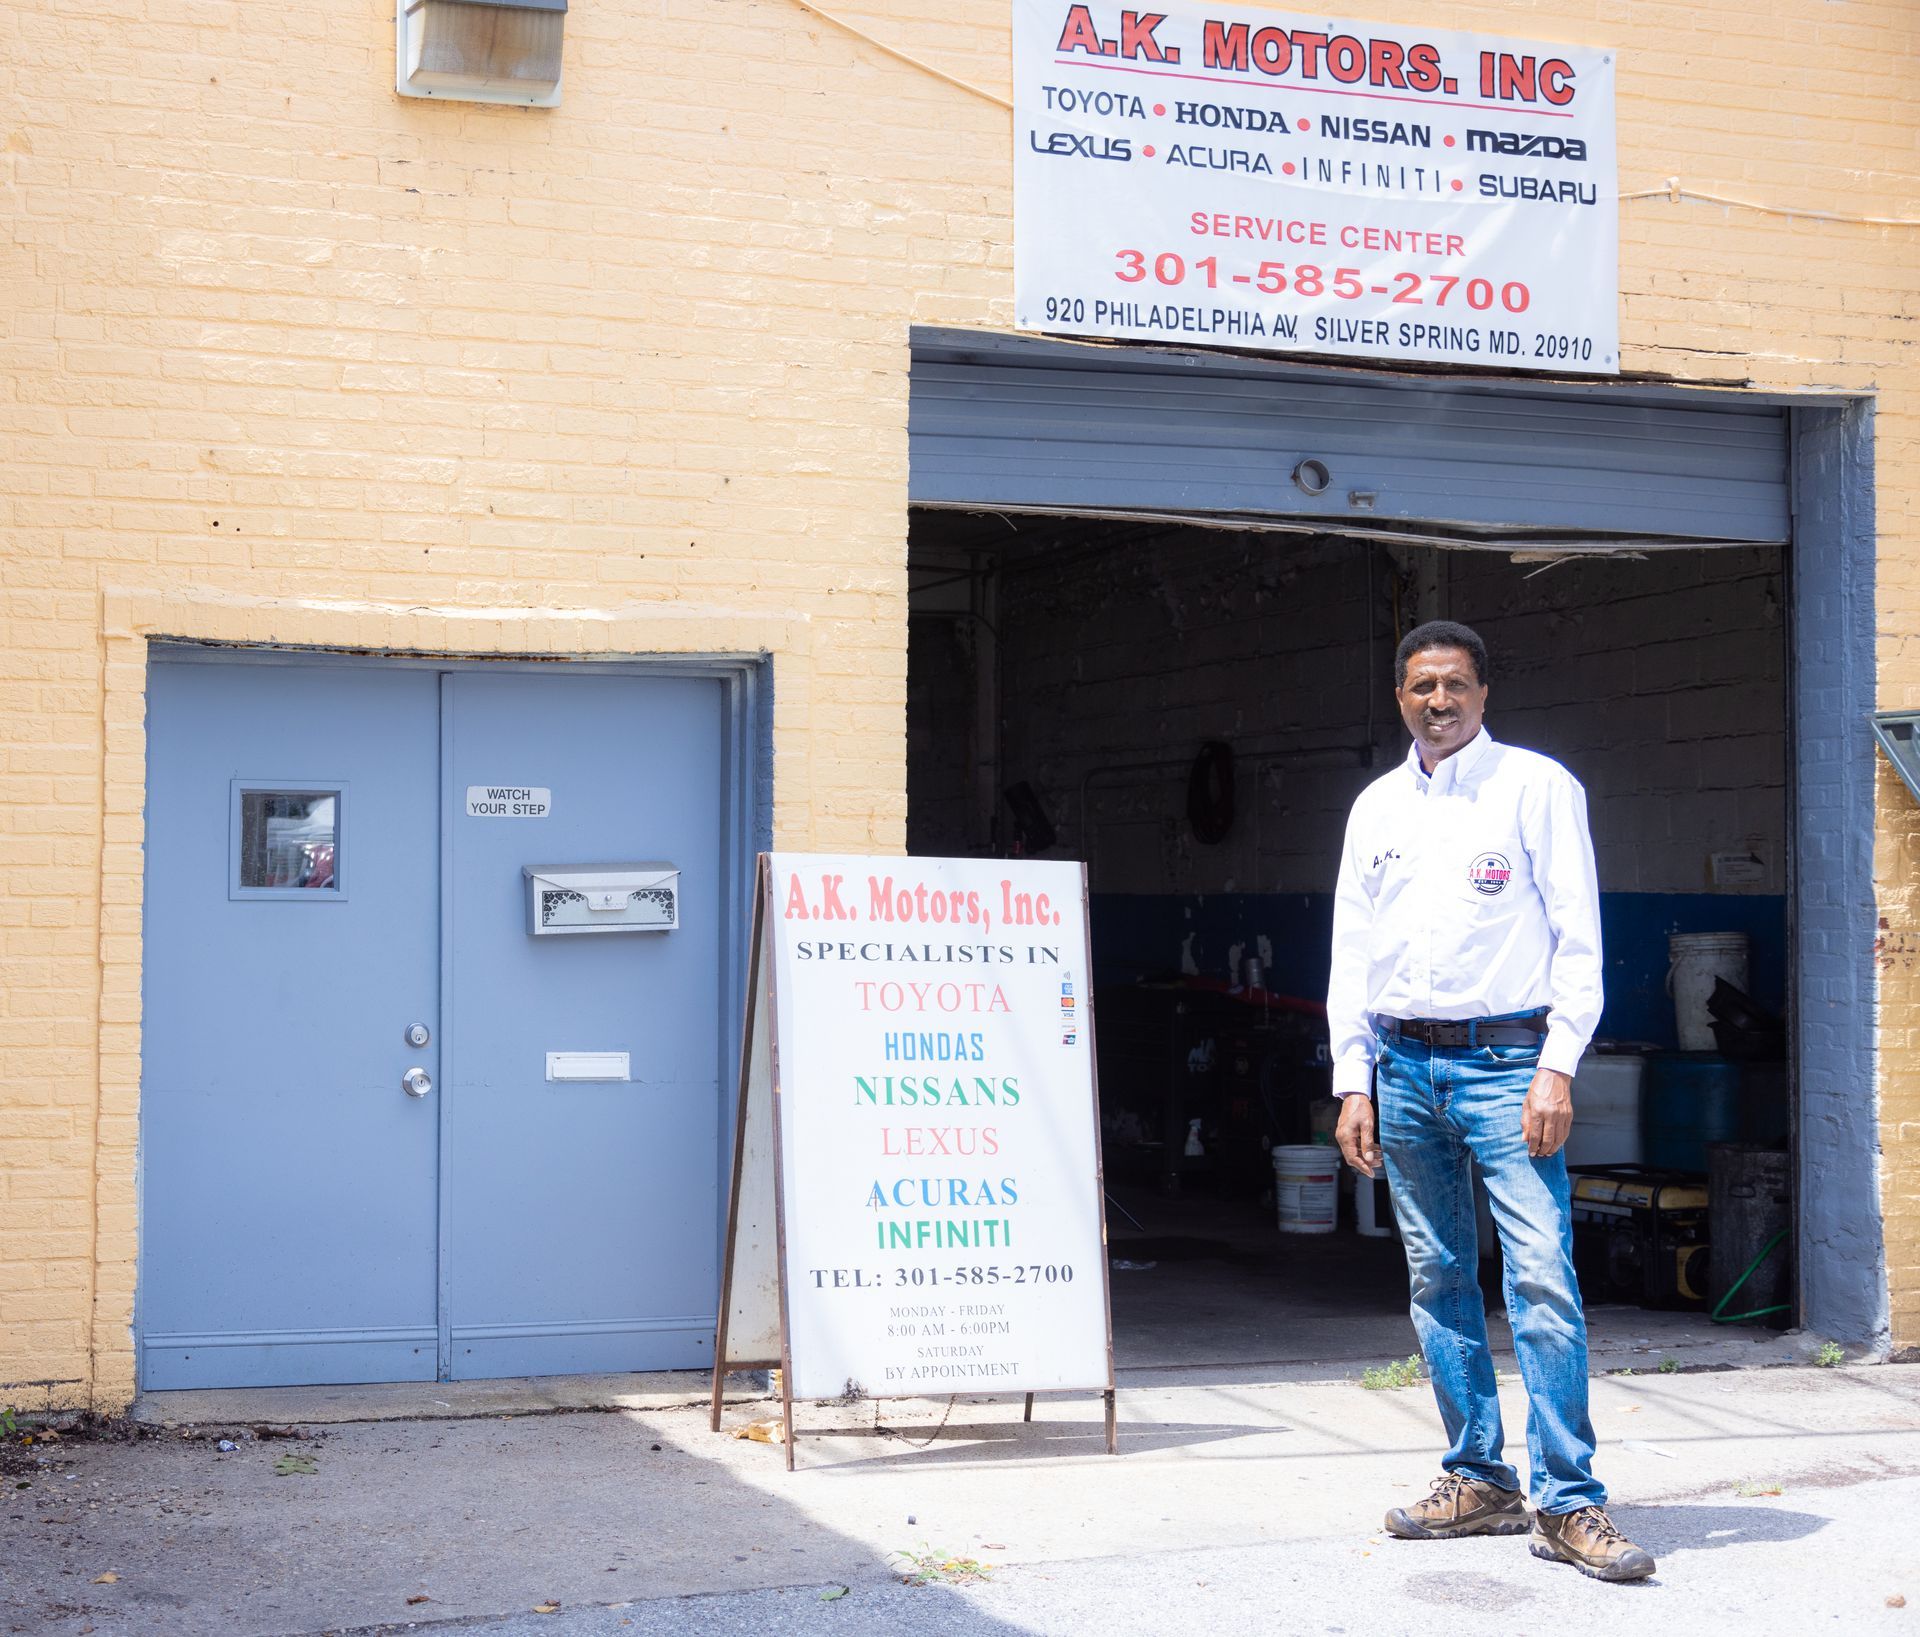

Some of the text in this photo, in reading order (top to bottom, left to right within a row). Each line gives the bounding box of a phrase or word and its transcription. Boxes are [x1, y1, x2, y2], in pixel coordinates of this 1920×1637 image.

[1056, 4, 1576, 106] A.K. MOTORS. INC
[1042, 86, 1147, 119] TOYOTA
[1174, 101, 1291, 135] HONDA
[1320, 115, 1431, 148] NISSAN
[1030, 130, 1597, 206] LEXUS ACURA INFINITI SUBARU
[1190, 211, 1466, 257] SERVICE CENTER
[1114, 249, 1531, 313] 301-585-2700
[1046, 297, 1085, 322] 920
[1094, 299, 1266, 336] PHILADELPHIA
[1314, 317, 1390, 346] SILVER
[1398, 324, 1481, 353] SPRING
[1488, 331, 1527, 357] MD.
[1534, 335, 1593, 361] 20910
[487, 788, 530, 800] WATCH
[472, 803, 545, 815] YOUR STEP
[1485, 869, 1510, 880] MOTORS
[785, 873, 1061, 935] A.K. Motors, Inc.
[797, 941, 1060, 964] SPECIALISTS IN
[855, 981, 1012, 1013] TOYOTA
[885, 1032, 984, 1061] HONDAS
[853, 1076, 1020, 1107] NISSANS
[882, 1127, 1000, 1156] LEXUS
[865, 1177, 1019, 1208] ACURAS
[878, 1219, 1010, 1249] INFINITI
[809, 1264, 1074, 1288] TEL: 301-585-2700
[889, 1306, 947, 1318] MONDAY
[959, 1304, 1005, 1317] FRIDAY
[887, 1324, 916, 1337] 8:00
[921, 1323, 946, 1337] AM
[960, 1322, 1010, 1336] 6:00PM
[917, 1346, 984, 1358] SATURDAY
[885, 1362, 1019, 1380] BY APPOINTMENT
